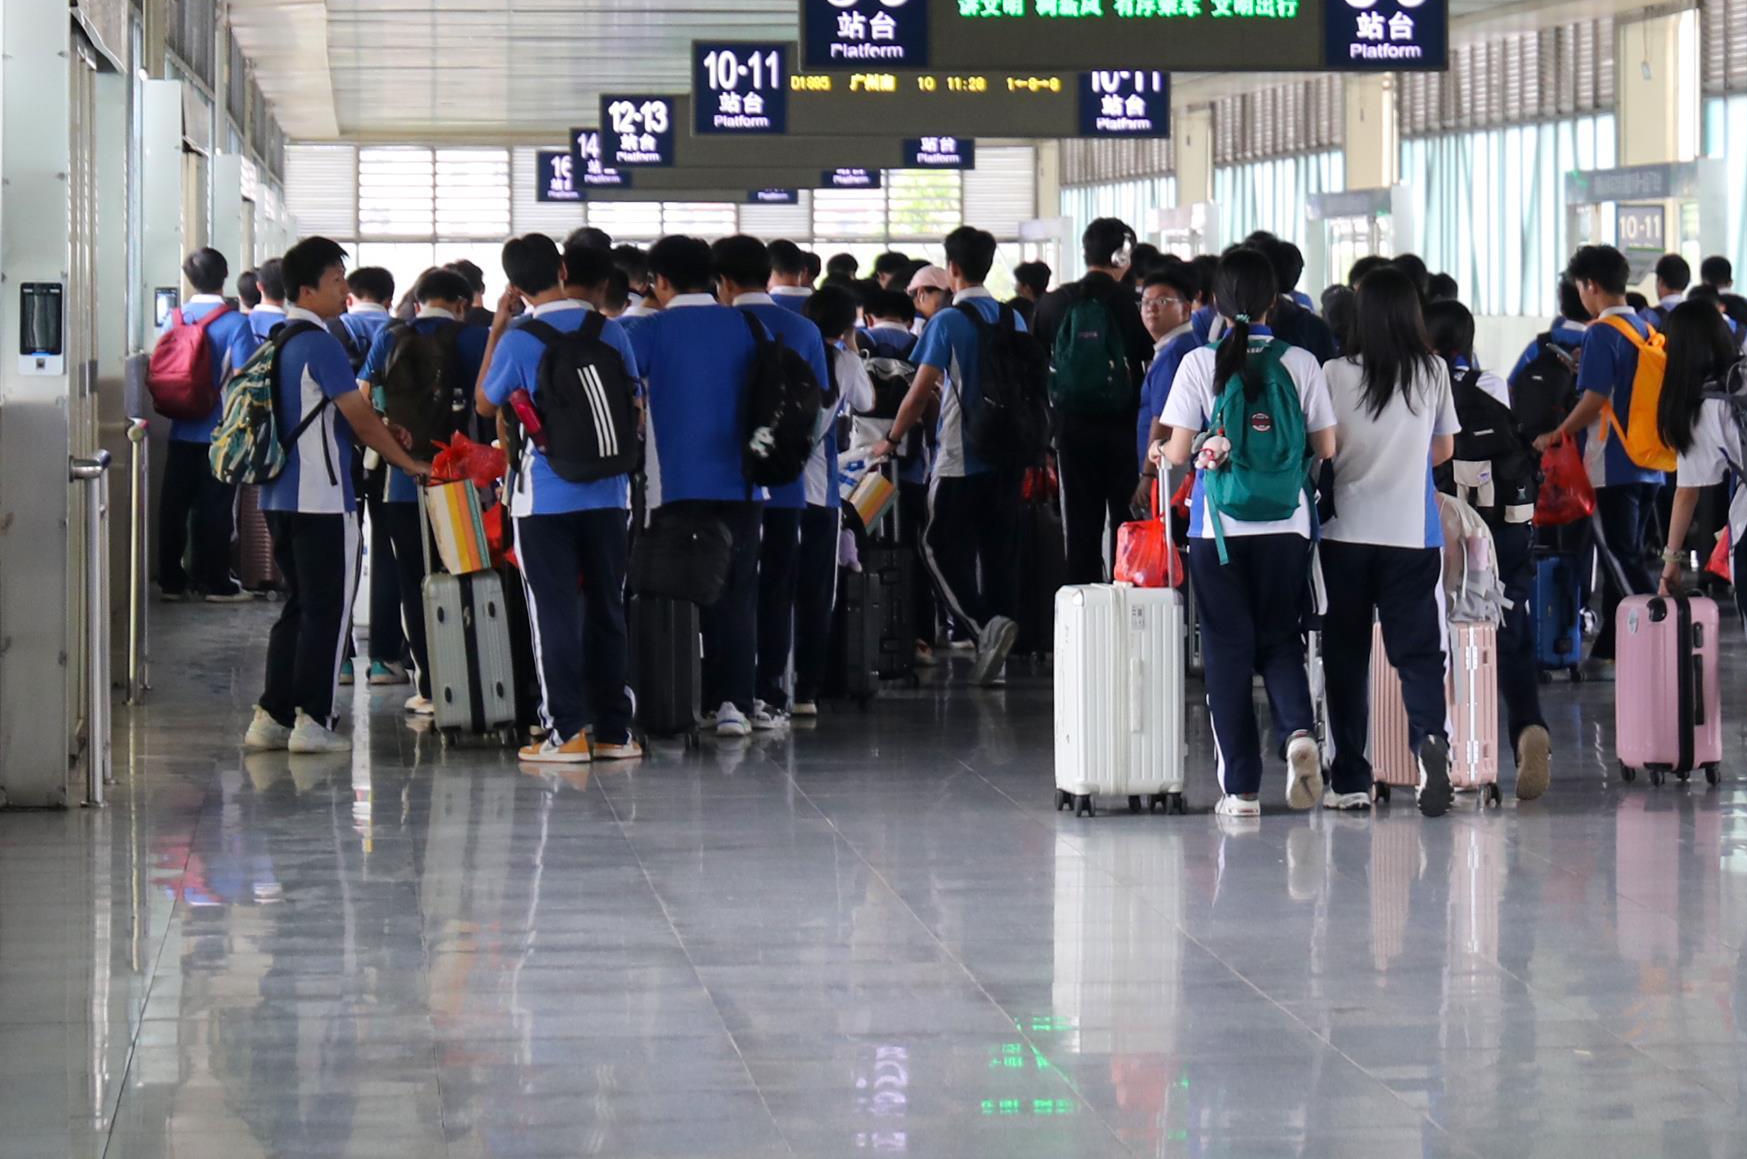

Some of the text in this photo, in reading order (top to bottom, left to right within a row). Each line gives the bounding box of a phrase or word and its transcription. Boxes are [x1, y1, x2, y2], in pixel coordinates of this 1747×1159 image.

[837, 10, 896, 40] 站台
[1356, 11, 1414, 40] 站台
[830, 43, 904, 58] Platform
[1349, 43, 1422, 58] Platform
[718, 91, 764, 114] 站台
[1101, 92, 1146, 117] 站台
[713, 115, 769, 128] Platform
[1096, 117, 1152, 131] Platform
[619, 133, 657, 152] 站台
[616, 151, 661, 163] Platform
